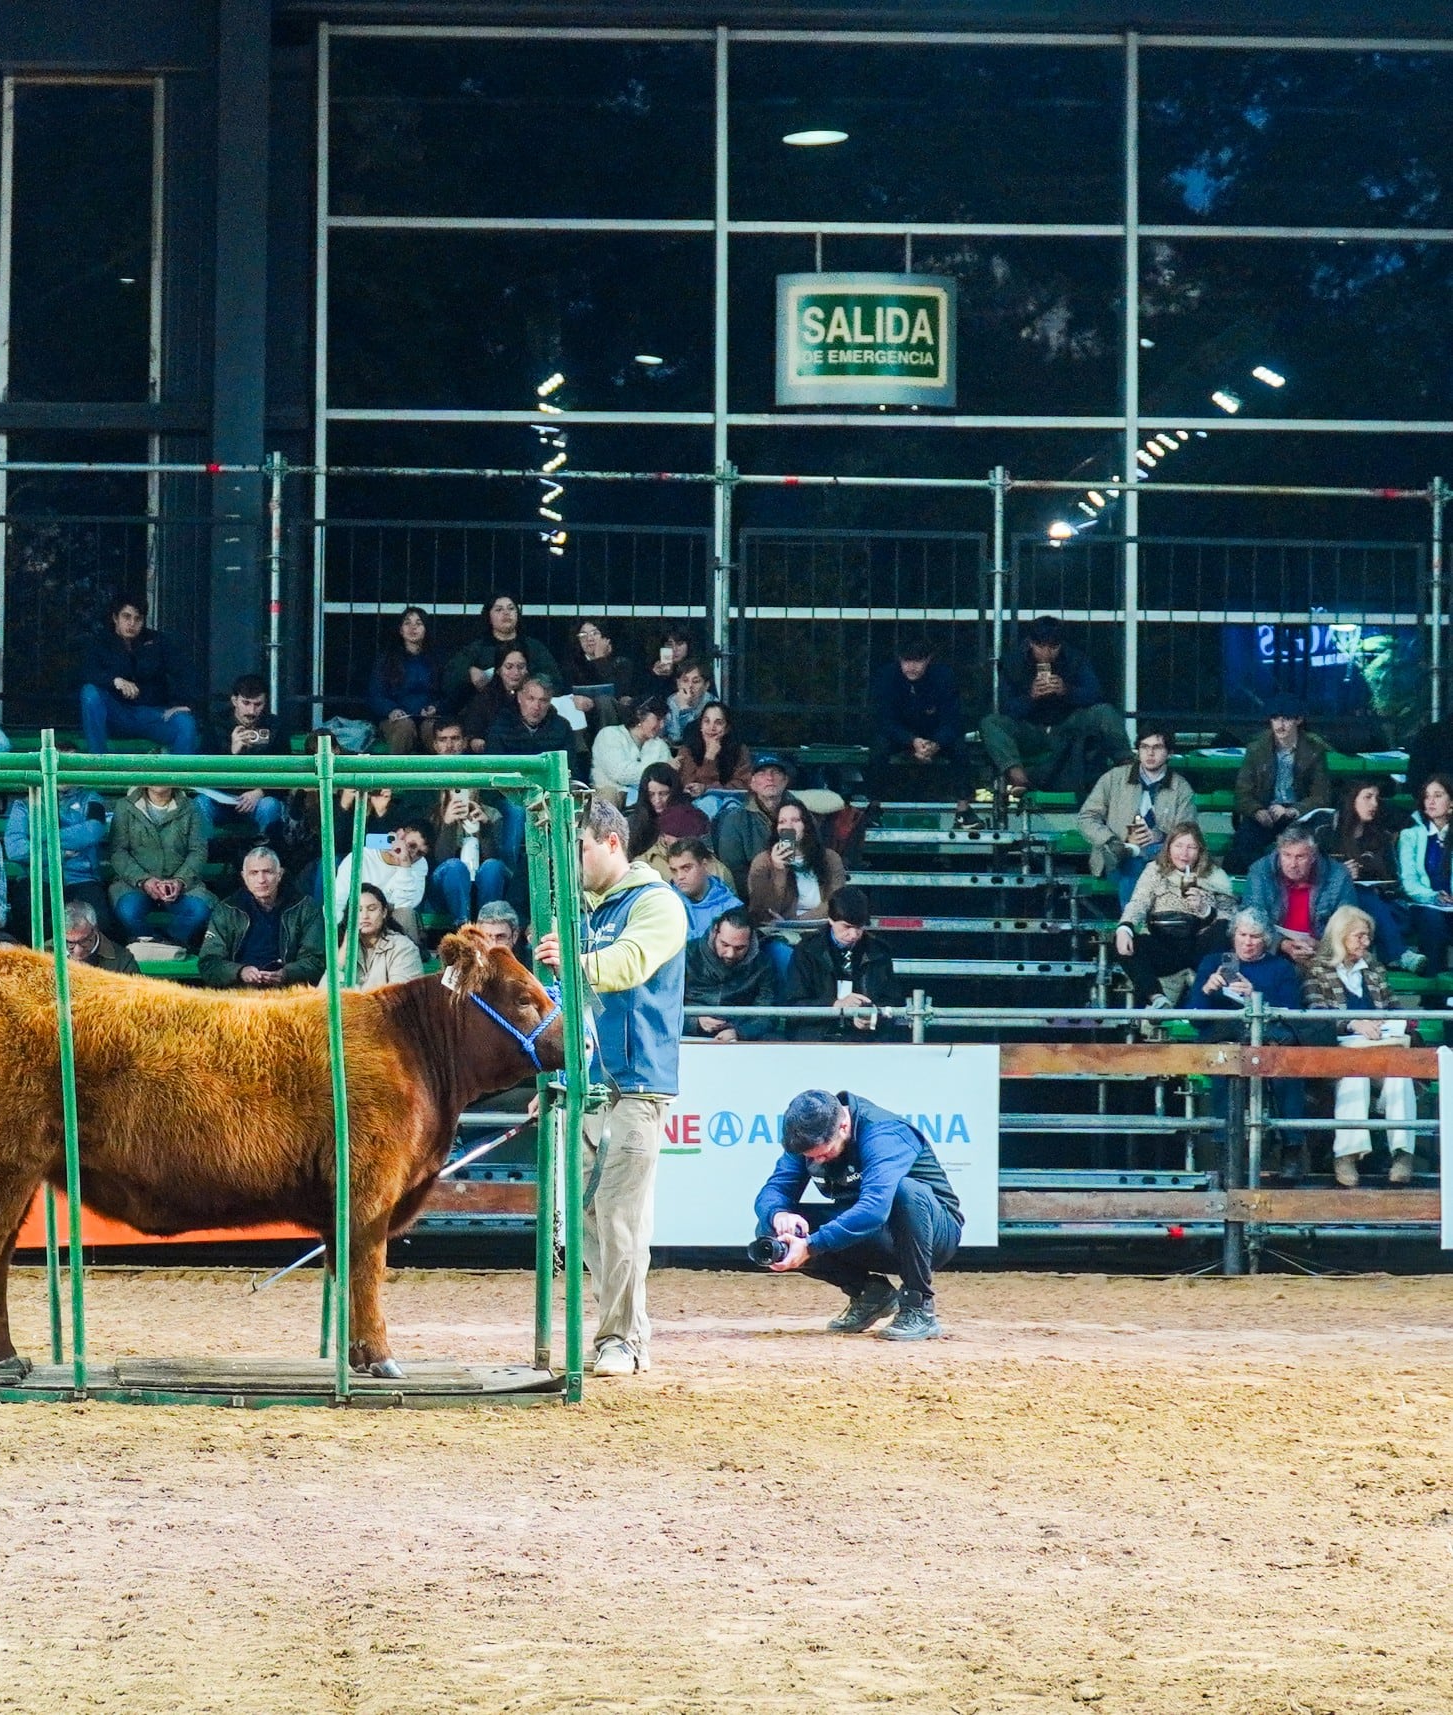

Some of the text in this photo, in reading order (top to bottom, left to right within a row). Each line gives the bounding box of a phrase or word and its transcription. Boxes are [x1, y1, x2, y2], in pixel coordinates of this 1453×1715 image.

[802, 305, 935, 346] SALIDA
[802, 349, 935, 366] DE EMERGENCIA
